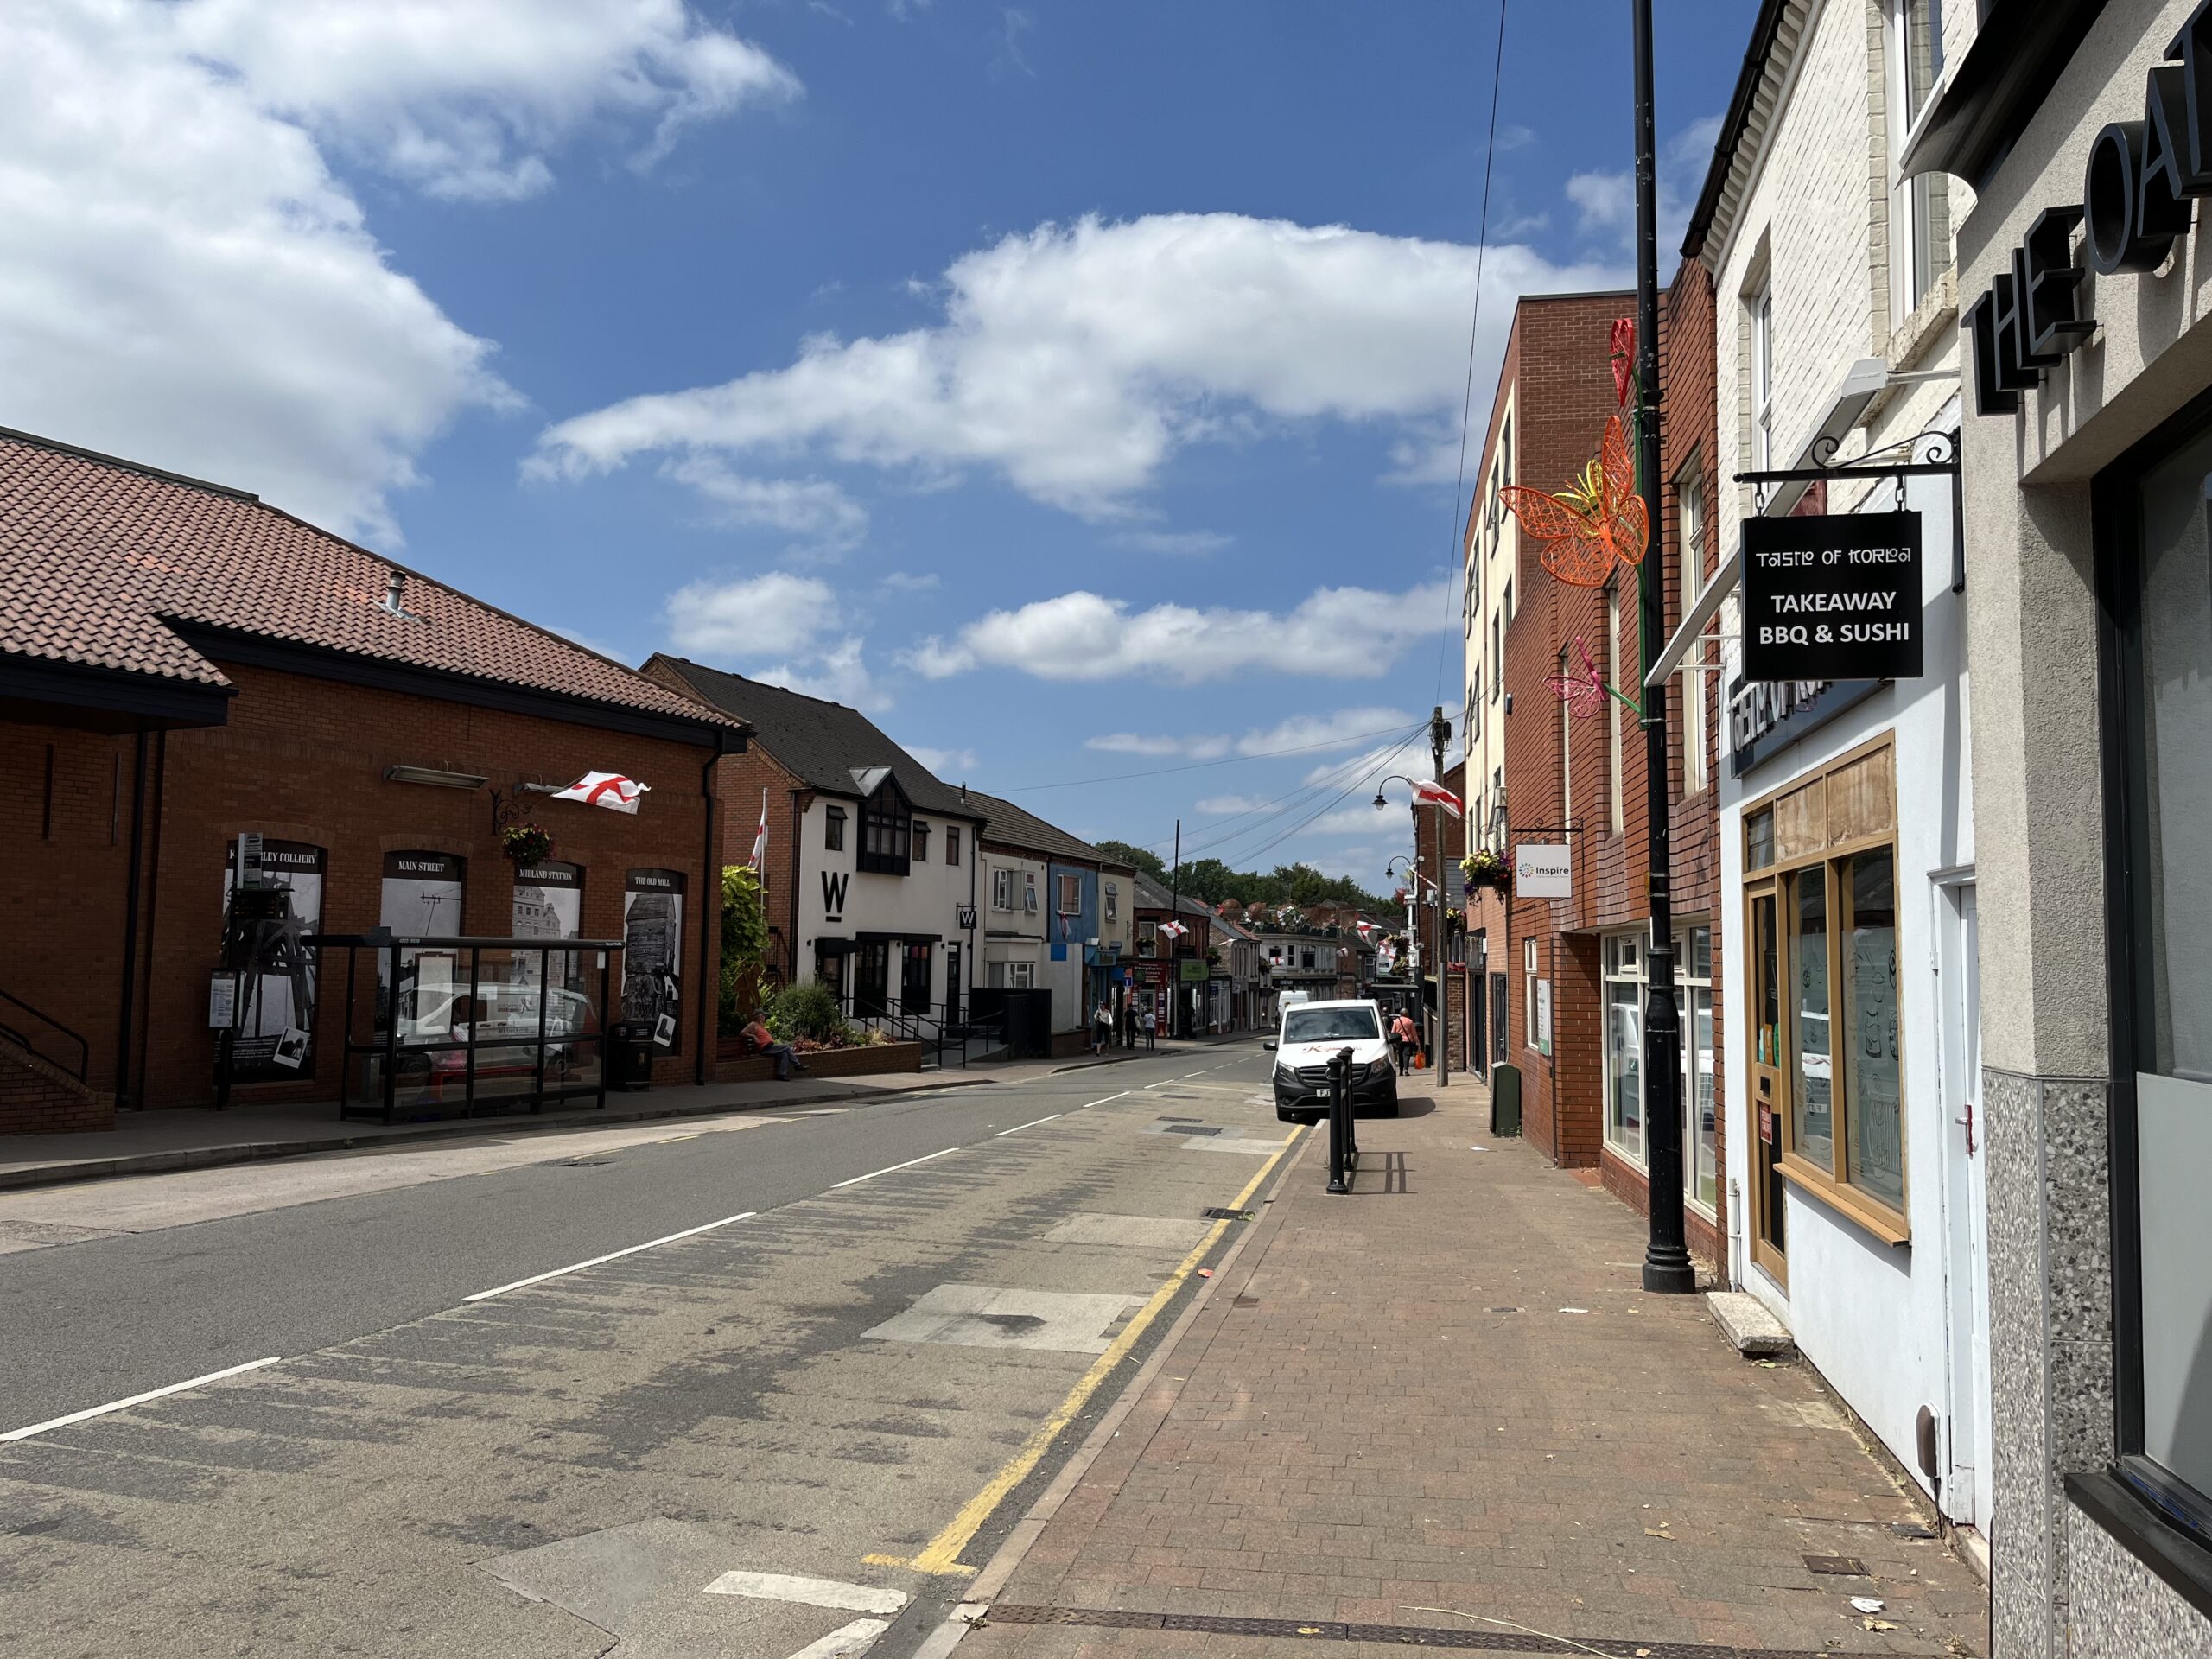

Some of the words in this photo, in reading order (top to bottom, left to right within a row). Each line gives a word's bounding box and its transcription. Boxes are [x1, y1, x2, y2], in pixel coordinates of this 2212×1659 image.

[1961, 204, 2087, 416] THE
[1821, 550, 1841, 565] OF
[1771, 592, 1897, 613] TAKEAWAY
[1759, 626, 1808, 646] BBQ
[1815, 625, 1833, 643] &
[1840, 623, 1910, 642] SUSHI
[280, 853, 317, 865] COLLIERY
[398, 861, 417, 871] MAIN
[418, 861, 444, 873] STREET
[1535, 866, 1569, 876] Inspire
[519, 868, 547, 880] MIDLAND
[548, 870, 572, 881] STATION
[634, 875, 645, 885] THE
[646, 876, 656, 886] OLD
[658, 877, 671, 887] MILL
[821, 870, 849, 913] W
[961, 912, 974, 924] W
